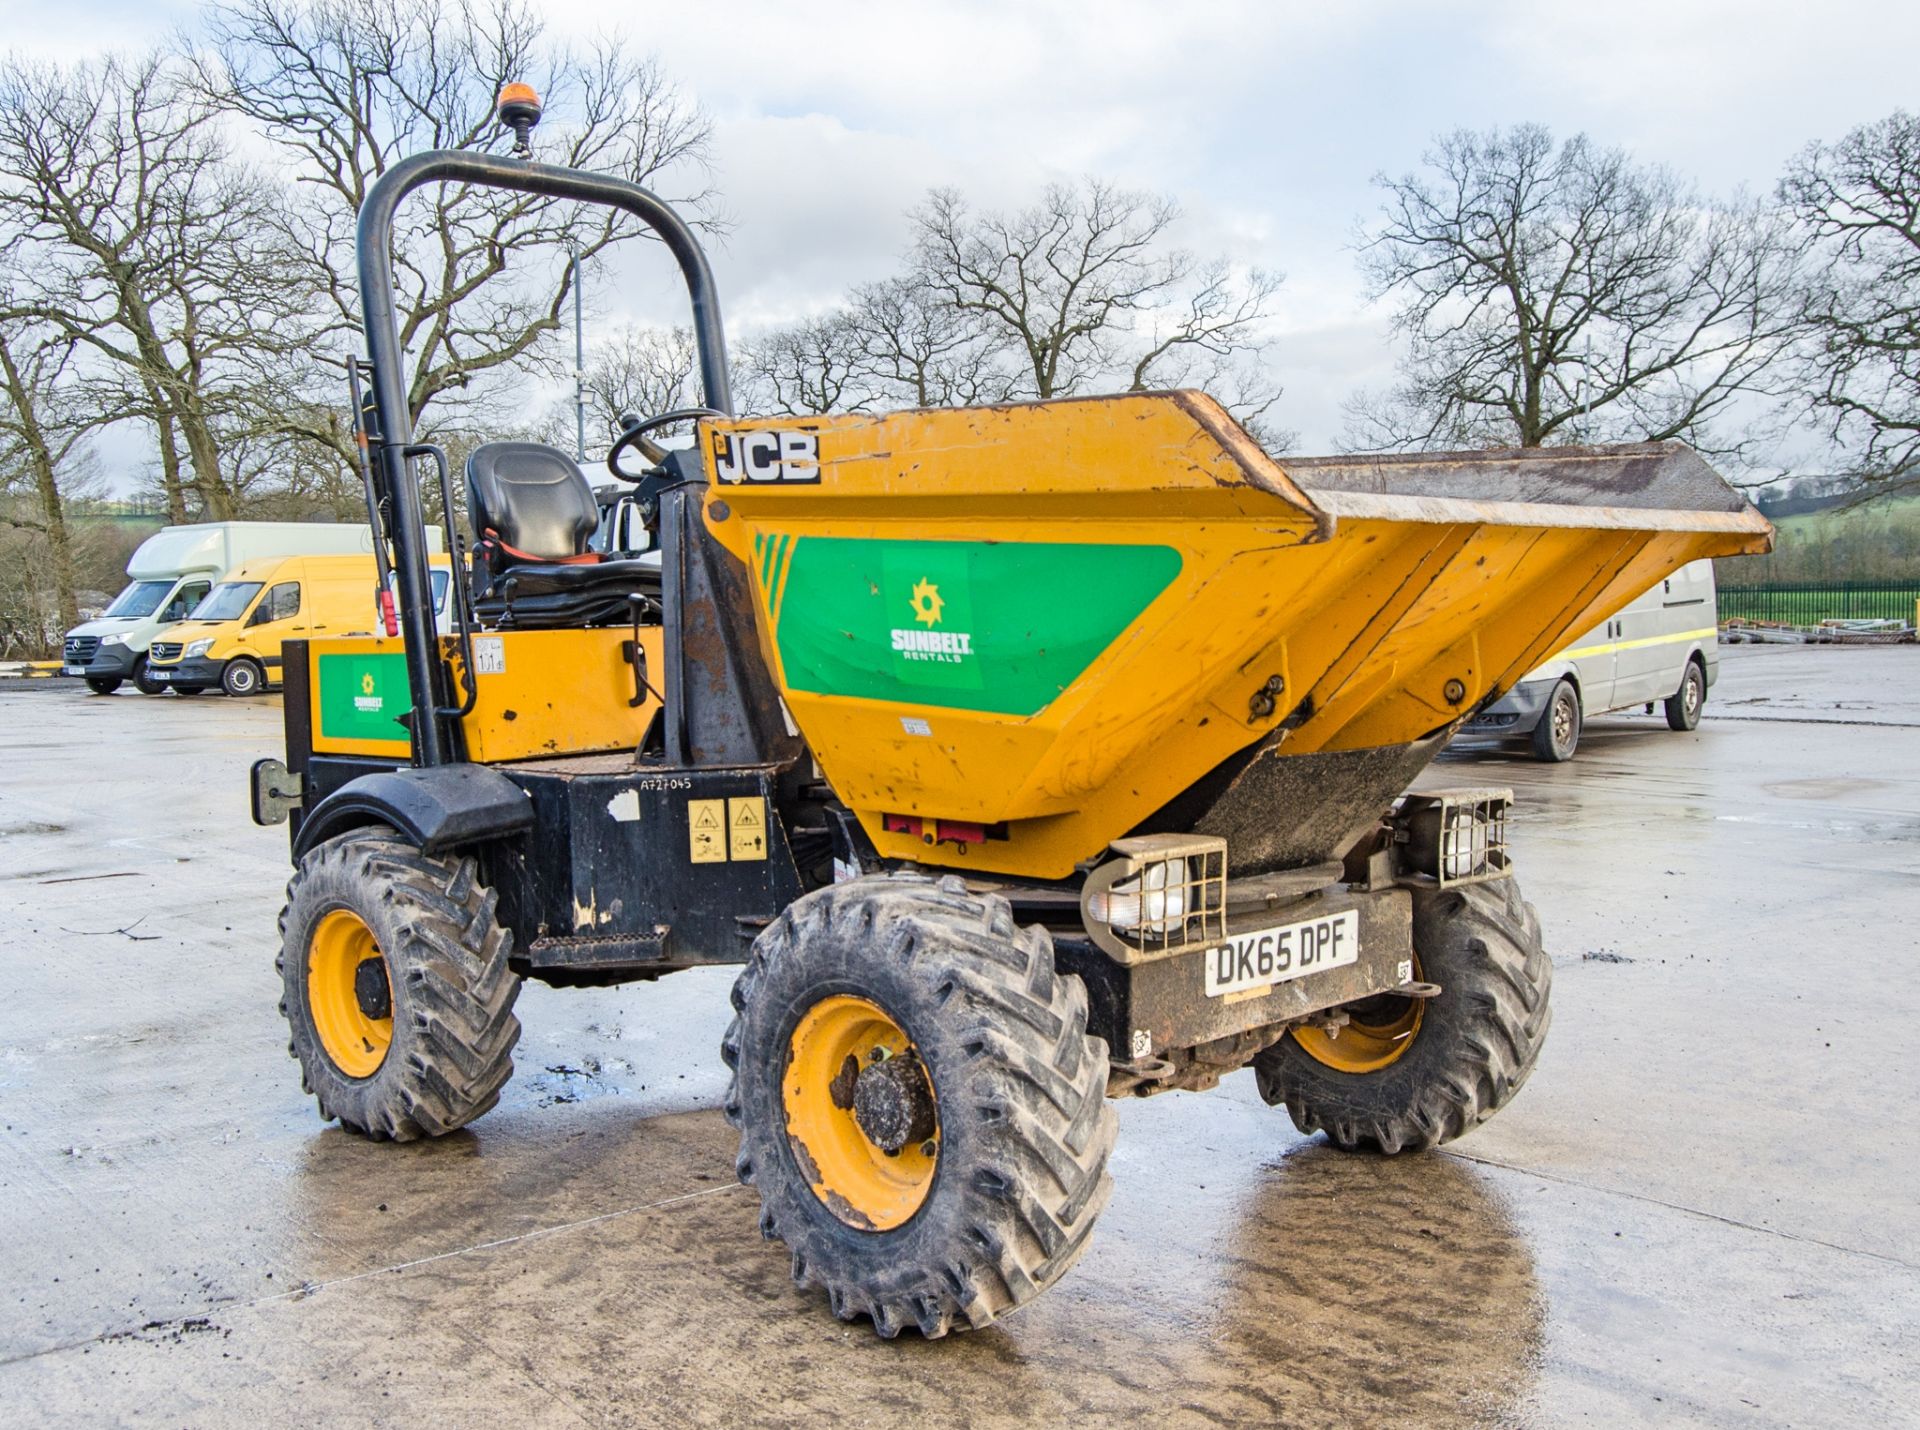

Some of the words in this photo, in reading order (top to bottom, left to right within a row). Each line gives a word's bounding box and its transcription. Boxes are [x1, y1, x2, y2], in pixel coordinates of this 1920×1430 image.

[717, 431, 819, 481] JCB
[891, 629, 970, 655] SUNBELT
[903, 651, 962, 663] RENTALS
[640, 777, 691, 791] A727045
[1216, 930, 1292, 986] DK65
[1300, 917, 1346, 967] DPF
